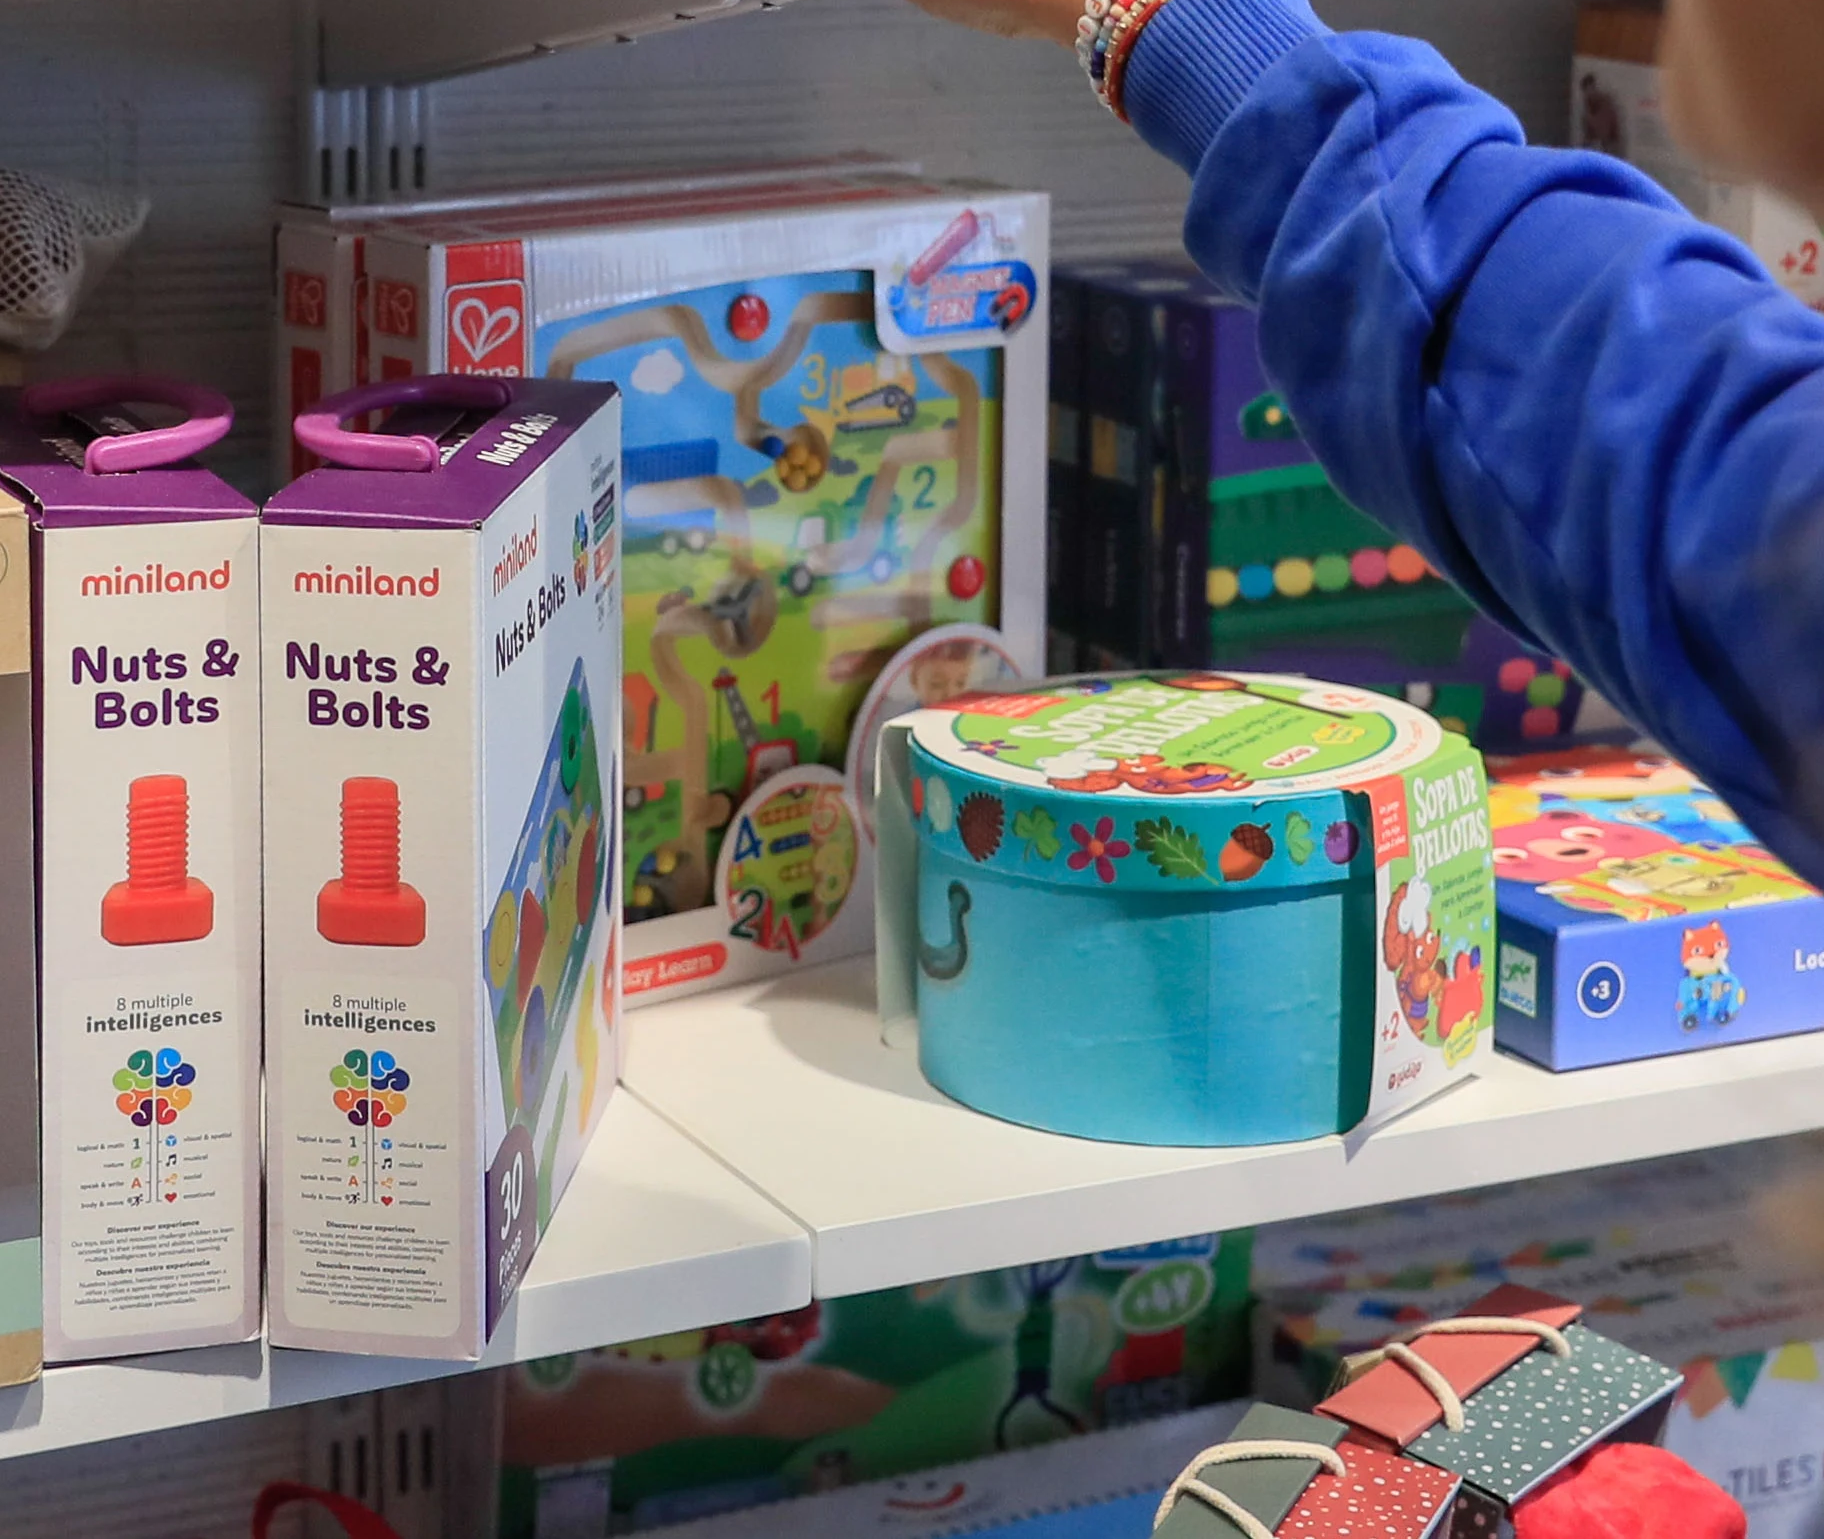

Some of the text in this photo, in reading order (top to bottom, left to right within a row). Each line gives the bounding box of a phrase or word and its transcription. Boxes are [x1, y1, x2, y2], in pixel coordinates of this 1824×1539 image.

[1780, 240, 1819, 276] +2
[927, 295, 977, 327] PEN
[799, 353, 827, 400] 3
[500, 431, 538, 445] &
[509, 412, 559, 437] Bolts
[475, 440, 528, 466] Nuts
[912, 465, 938, 510] 2
[492, 513, 538, 598] miniland
[80, 559, 231, 597] miniland
[293, 564, 440, 598] miniland
[495, 572, 567, 678] Nuts & Bolts
[71, 637, 241, 686] Nuts &
[285, 640, 451, 687] Nuts &
[94, 687, 220, 730] Bolts
[307, 688, 431, 731] Bolts
[761, 680, 780, 724] 1
[1413, 773, 1458, 829] SOPA
[1456, 764, 1480, 807] DE
[734, 814, 764, 862] 4
[729, 889, 764, 939] 2
[116, 993, 194, 1012] 8 multiple
[332, 994, 407, 1013] 8 multiple
[1590, 980, 1612, 1000] +3
[85, 1008, 223, 1035] intelligences
[303, 1009, 437, 1035] intelligences
[1381, 1010, 1400, 1042] +2
[500, 1150, 524, 1241] 30
